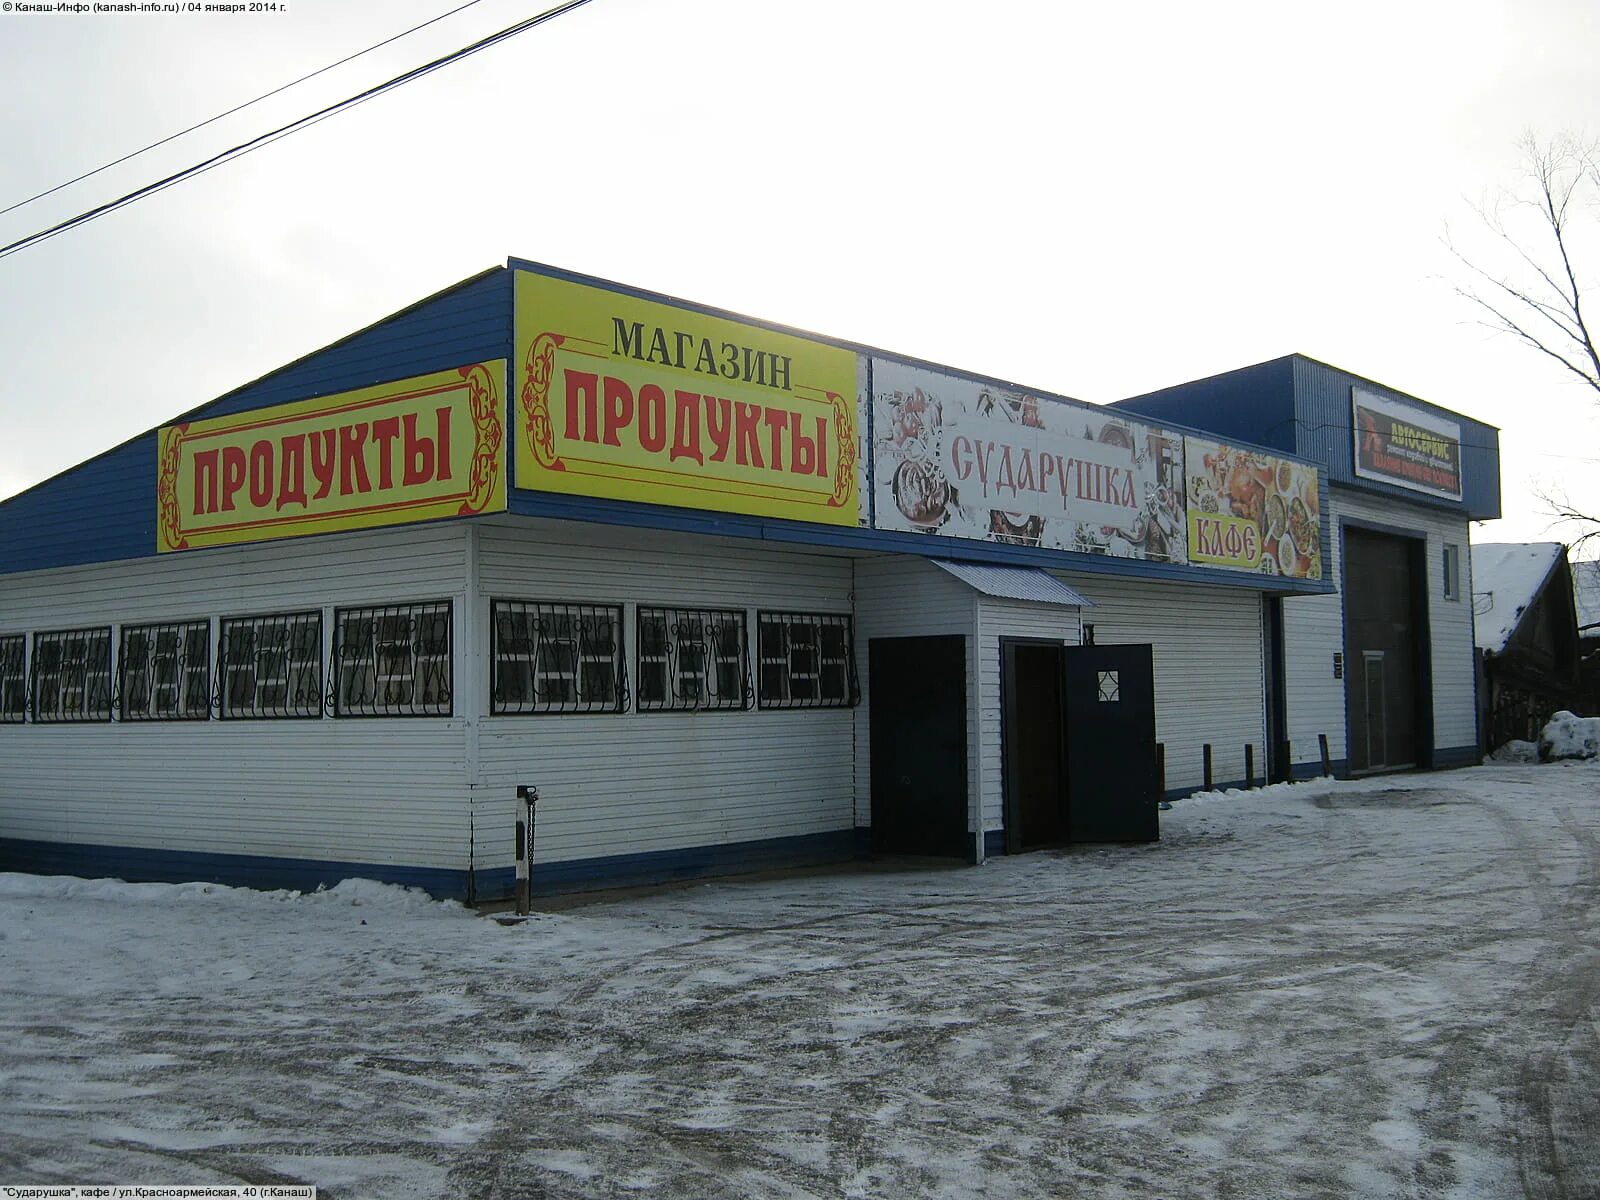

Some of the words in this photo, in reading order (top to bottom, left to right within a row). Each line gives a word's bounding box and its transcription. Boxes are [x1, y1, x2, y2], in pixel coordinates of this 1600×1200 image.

[611, 317, 792, 391] МАГАЗИН
[193, 406, 452, 515] ПРОДУКТЫ
[564, 369, 828, 478] ПРОДУКТЫ
[952, 436, 1138, 511] СУДАРУШКА
